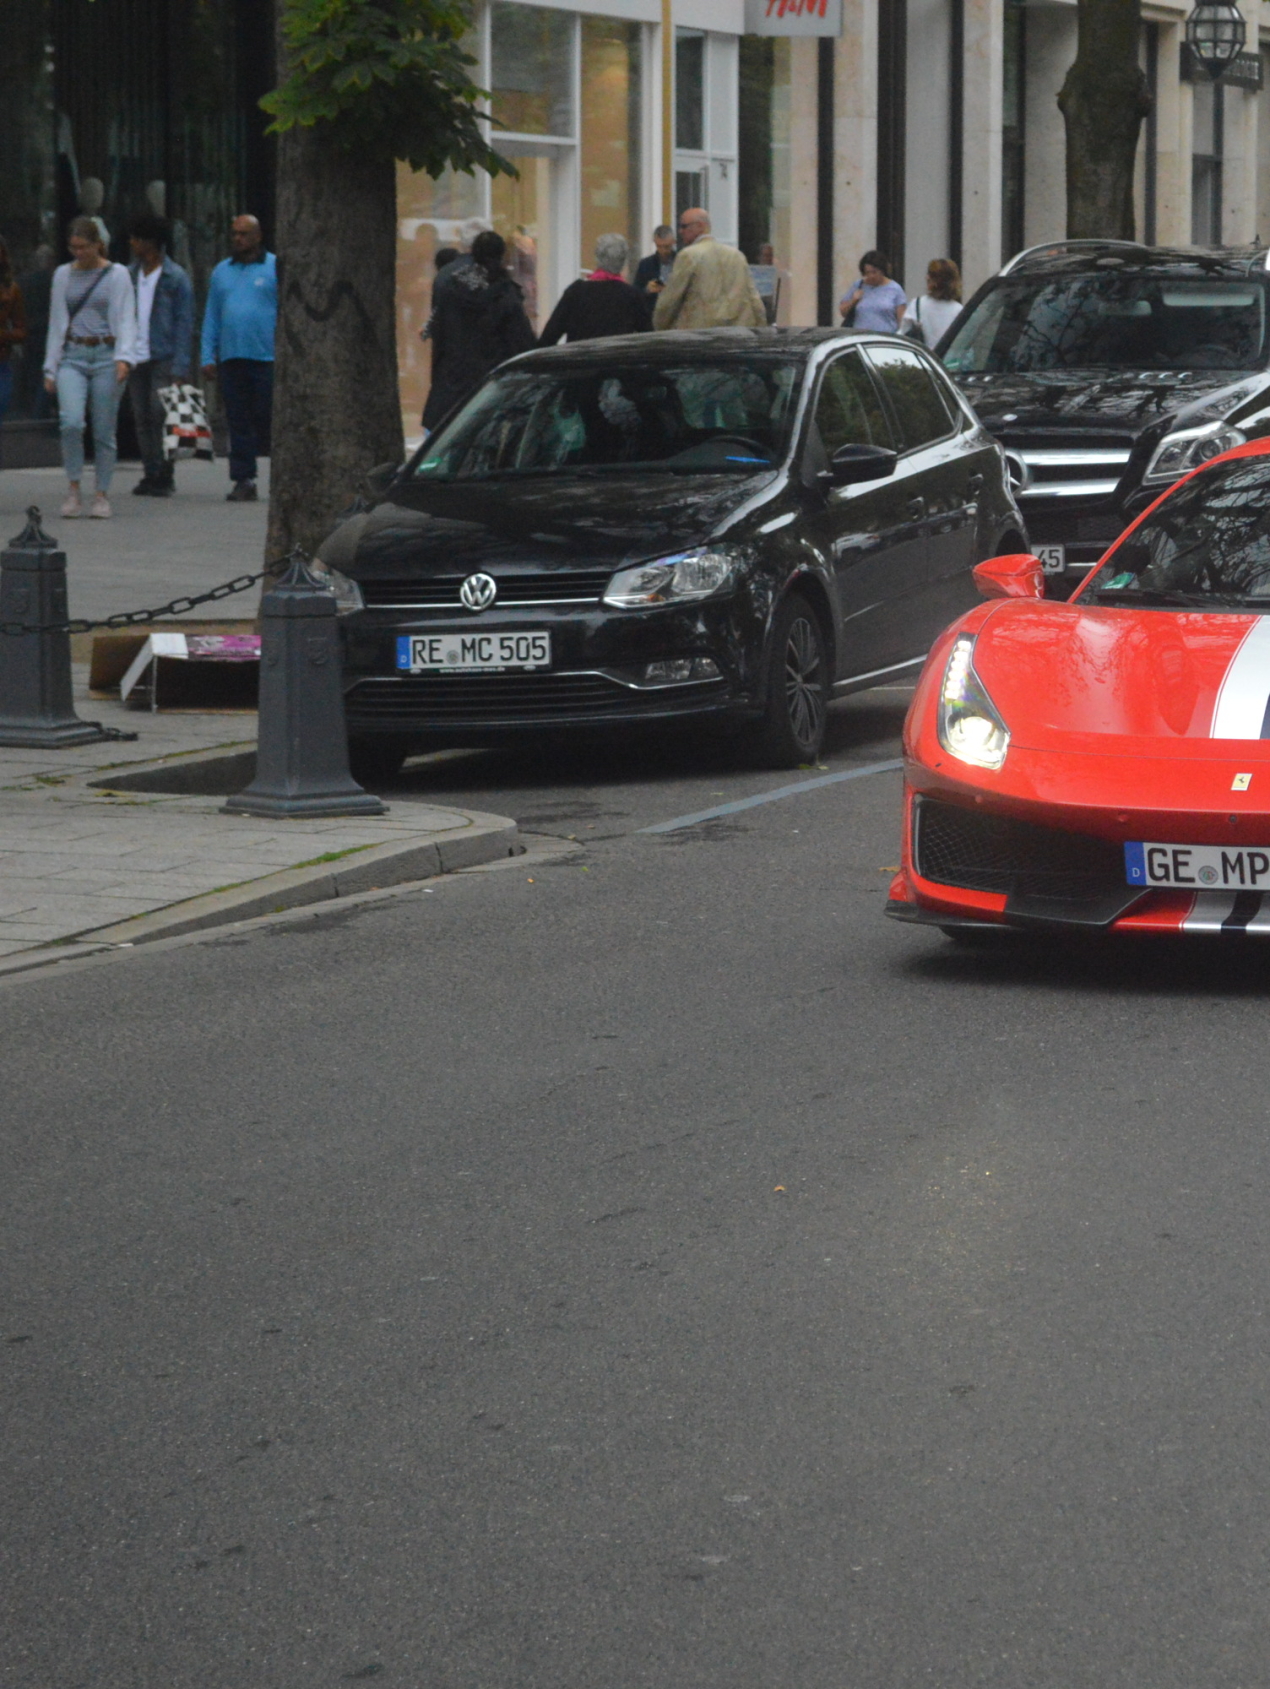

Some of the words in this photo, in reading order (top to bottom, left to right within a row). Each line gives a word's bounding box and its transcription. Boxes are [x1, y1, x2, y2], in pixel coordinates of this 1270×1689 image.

[412, 639, 444, 665] RE
[461, 637, 493, 663] MC
[499, 636, 547, 661] 505
[1131, 867, 1141, 878] D
[1146, 847, 1196, 883] GE
[1221, 851, 1270, 885] MP
